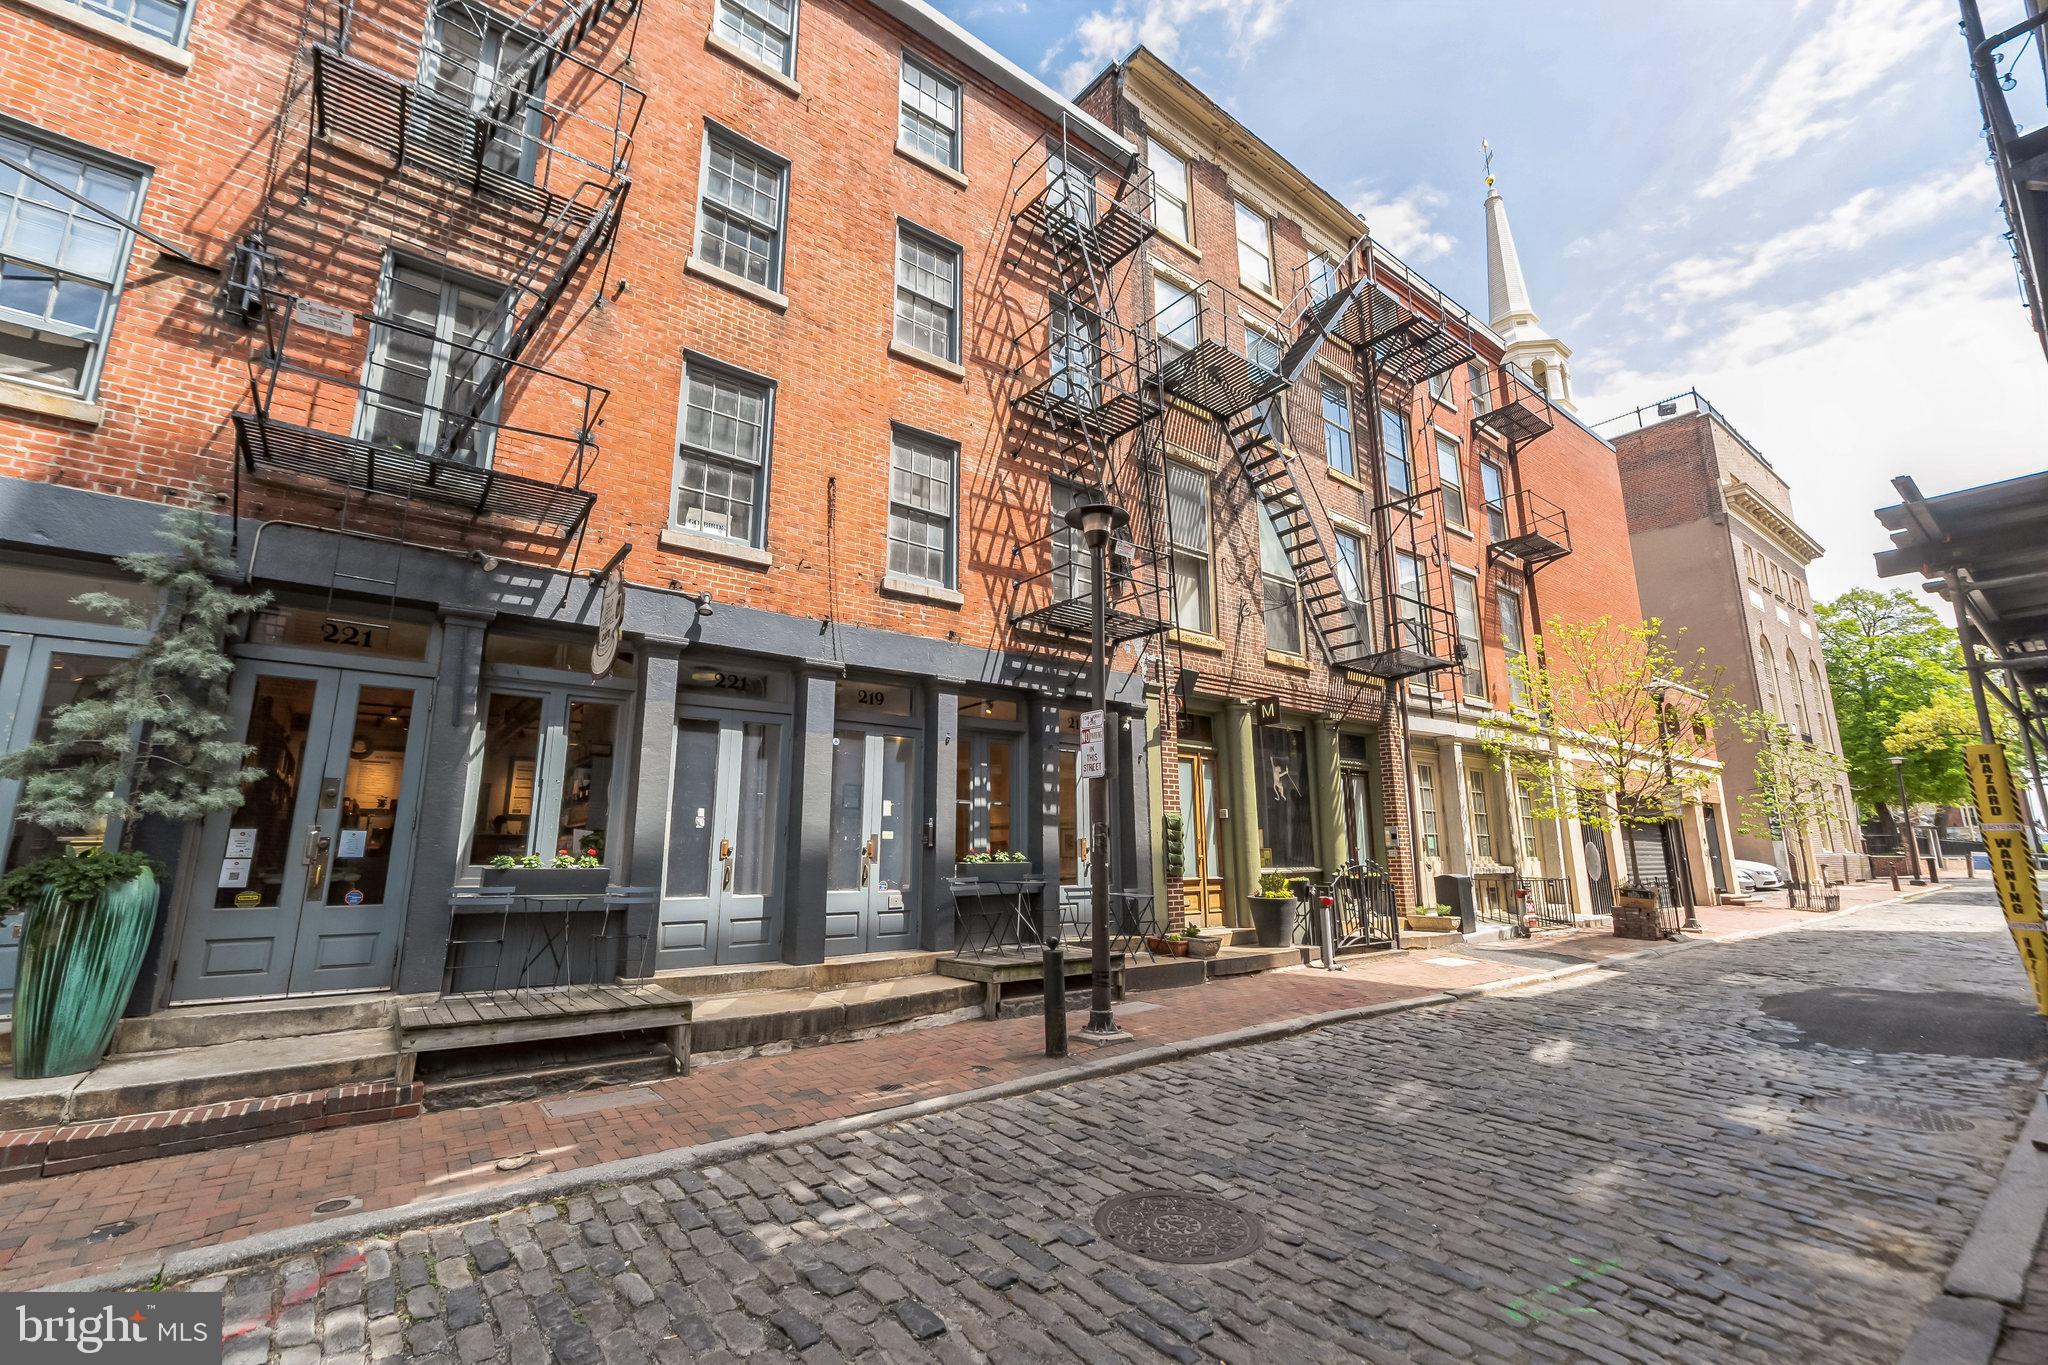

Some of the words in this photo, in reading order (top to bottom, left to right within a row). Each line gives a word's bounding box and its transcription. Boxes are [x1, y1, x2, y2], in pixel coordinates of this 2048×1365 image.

[321, 622, 372, 648] 221
[714, 672, 747, 690] 221
[858, 689, 885, 706] 219
[1261, 703, 1275, 718] M
[1068, 718, 1080, 730] 21
[1082, 730, 1090, 743] NO
[1086, 754, 1098, 762] THIS
[1083, 762, 1102, 773] STREET
[1979, 753, 2002, 816] HAZARD
[1994, 838, 2024, 915] WARNING
